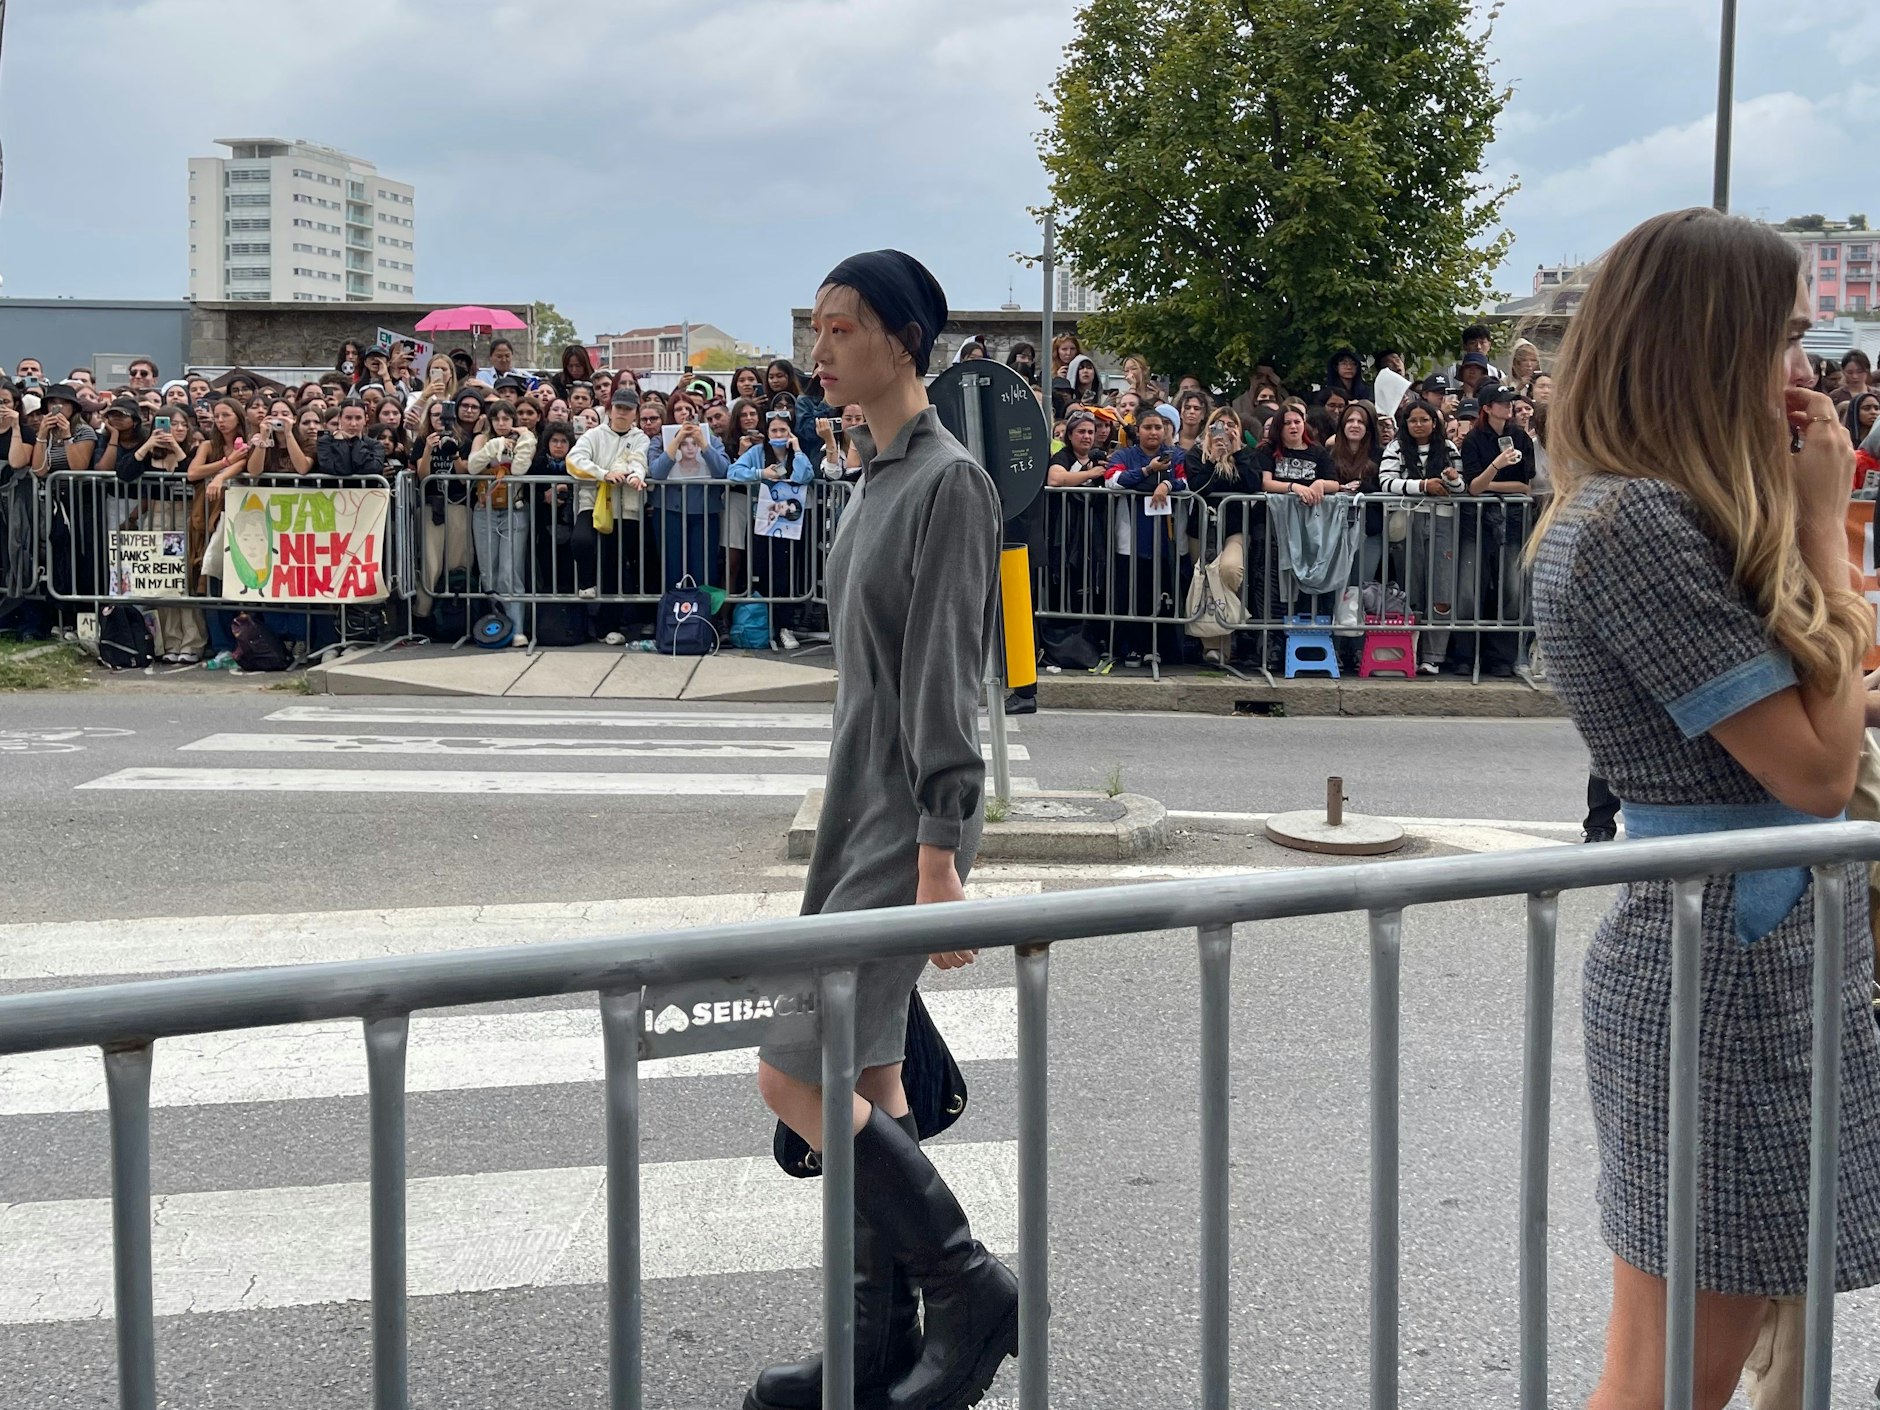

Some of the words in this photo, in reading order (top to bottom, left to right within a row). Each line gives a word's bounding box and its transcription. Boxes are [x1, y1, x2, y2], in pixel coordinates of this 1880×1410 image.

[270, 491, 337, 533] JAY
[279, 532, 375, 566] NI-KI
[132, 562, 151, 574] FOR
[135, 577, 146, 589] IN
[148, 579, 163, 589] MY
[271, 562, 379, 598] MINAJ
